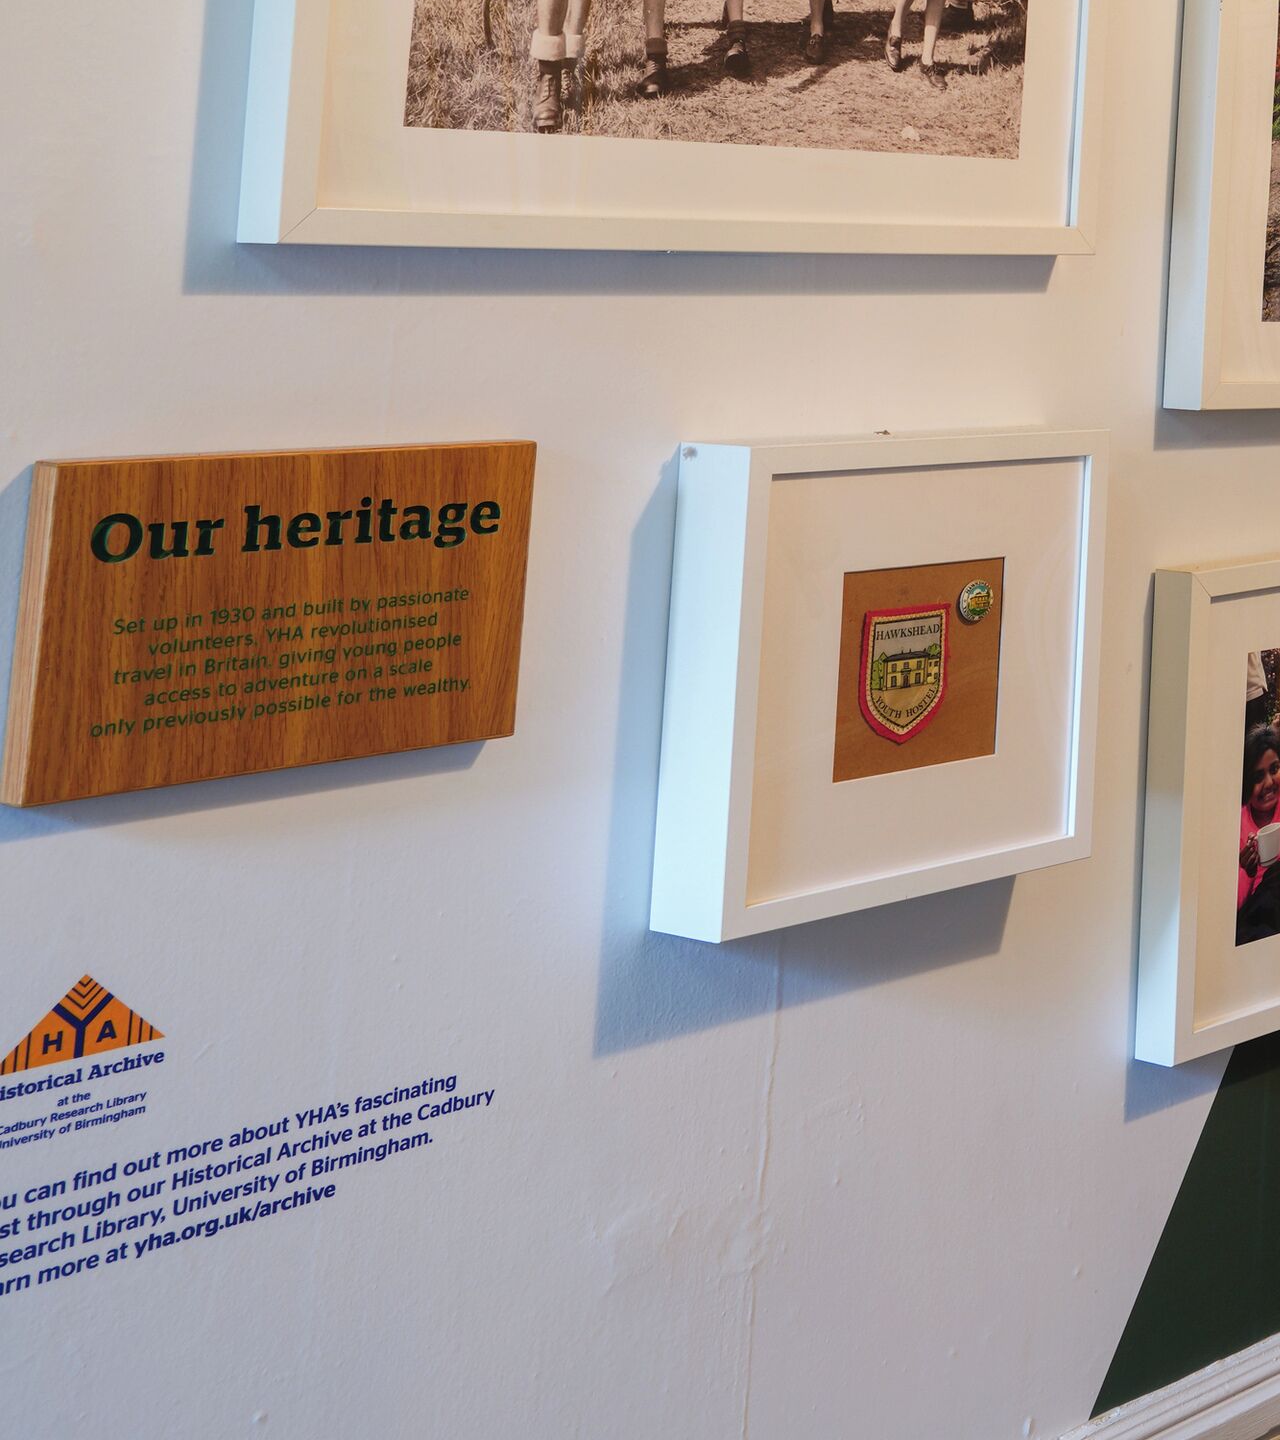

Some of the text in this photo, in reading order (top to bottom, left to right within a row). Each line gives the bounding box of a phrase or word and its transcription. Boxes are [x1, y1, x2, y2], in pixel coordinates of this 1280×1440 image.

[90, 496, 500, 563] Our heritage
[113, 588, 469, 636] Set up in 1930 and built by passionate
[266, 627, 304, 642] YHA
[311, 612, 438, 639] revolutionised
[876, 624, 940, 640] HAWKSHEAD
[113, 663, 172, 684] travel
[179, 661, 196, 677] in
[279, 647, 336, 668] giving
[343, 641, 397, 659] young
[403, 632, 462, 655] people
[144, 659, 433, 706] access to adventure on a scale
[89, 718, 136, 738] only
[143, 701, 246, 733] previously
[253, 694, 331, 718] possible
[337, 690, 362, 705] for
[369, 686, 396, 702] the
[875, 688, 936, 718] YOUTH HOSTEL
[0, 1051, 165, 1101] istorical Archive
[57, 1091, 91, 1107] at the
[50, 1103, 103, 1123] Research
[106, 1091, 147, 1109] Library
[59, 1123, 72, 1135] of
[75, 1105, 146, 1131] Birmingham
[24, 1180, 66, 1204] can
[73, 1163, 117, 1190] find
[123, 1151, 162, 1176] out
[166, 1138, 223, 1165] more
[229, 1117, 289, 1147] about
[355, 1075, 457, 1113] fascinating
[27, 1191, 120, 1231] through
[127, 1179, 166, 1203] our
[171, 1147, 271, 1190] Historical
[276, 1128, 352, 1161] Archive
[358, 1119, 377, 1138] at
[382, 1111, 412, 1130] the
[417, 1089, 495, 1121] Cadbury
[82, 1207, 166, 1244] Library,
[173, 1174, 280, 1216] University
[285, 1163, 306, 1184] of
[311, 1131, 433, 1177] Birmingham.
[37, 1254, 99, 1284] more
[105, 1242, 128, 1264] at
[134, 1183, 336, 1259] yha.org.uk/archive
